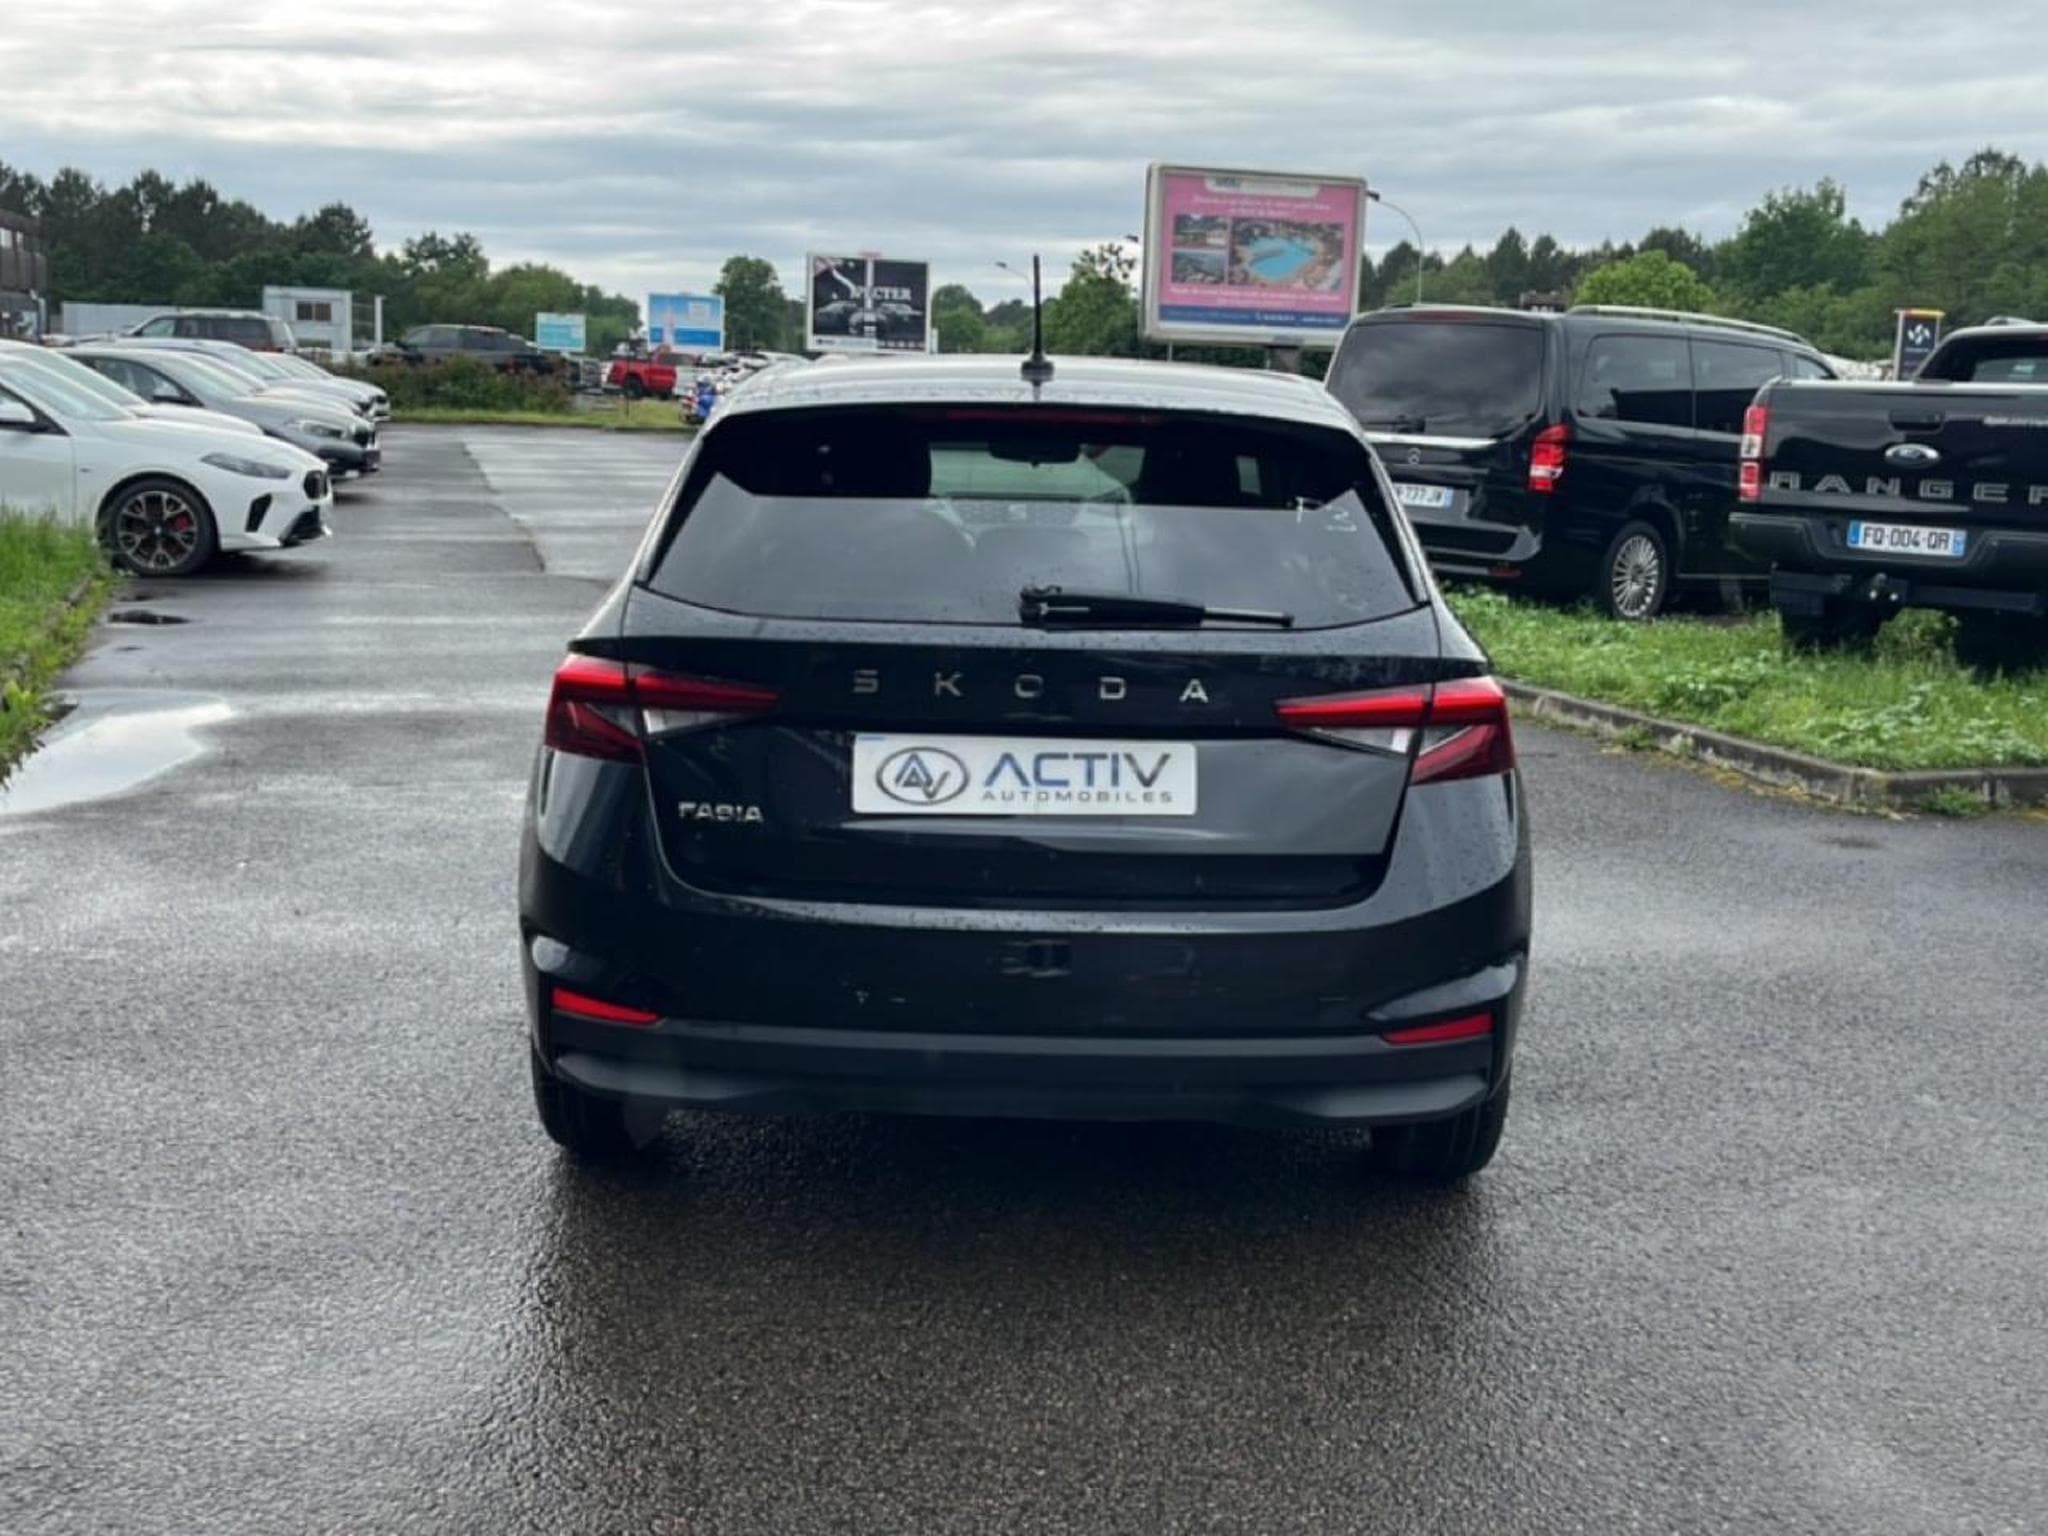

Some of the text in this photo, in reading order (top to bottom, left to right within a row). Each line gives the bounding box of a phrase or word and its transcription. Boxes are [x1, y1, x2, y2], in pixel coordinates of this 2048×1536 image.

[853, 669, 1209, 702] SKODA
[985, 752, 1171, 787] ACTIV
[982, 790, 1173, 803] AUTOMOBILES
[678, 802, 764, 821] FABIA
